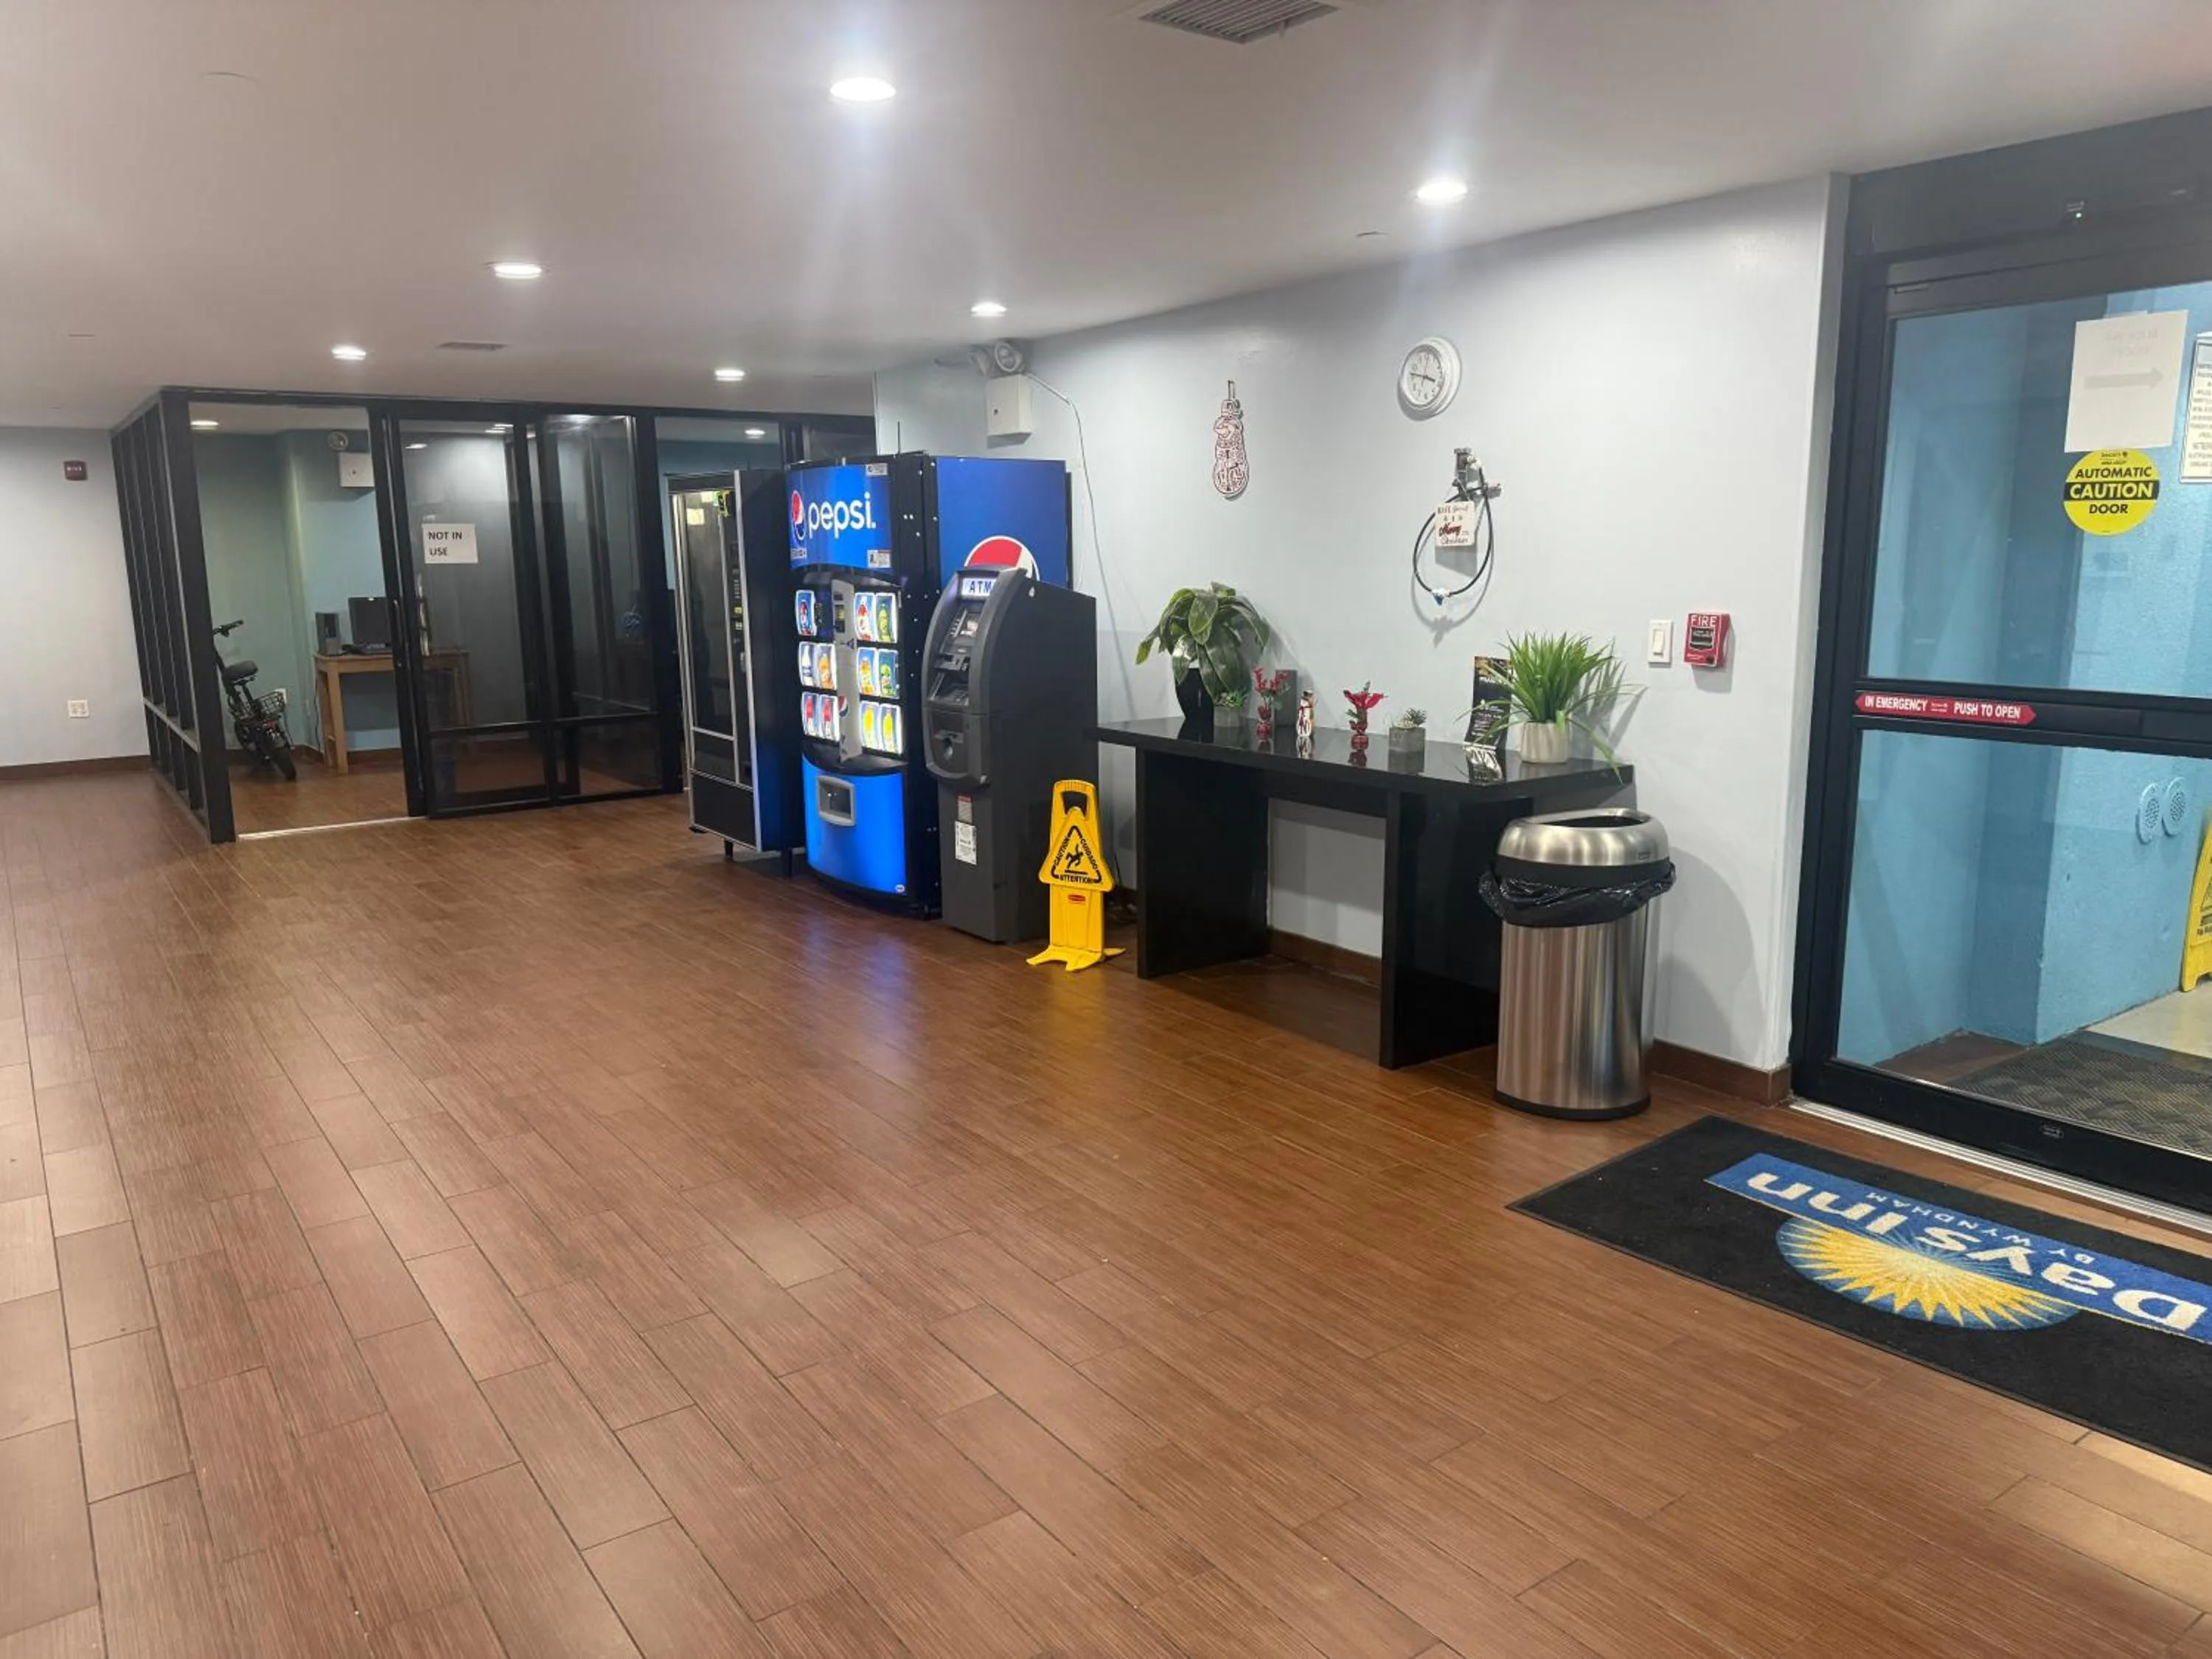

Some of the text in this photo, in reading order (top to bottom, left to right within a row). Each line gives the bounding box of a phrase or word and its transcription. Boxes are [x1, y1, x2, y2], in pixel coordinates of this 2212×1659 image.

[2076, 467, 2152, 479] AUTOMATIC
[2070, 482, 2153, 498] CAUTION
[2089, 504, 2129, 513] DOOR
[428, 532, 462, 540] NOT IN
[429, 547, 448, 556] USE
[970, 580, 992, 594] ATM
[1691, 614, 1717, 627] FIRE
[1865, 695, 1874, 707] IN
[1875, 696, 1928, 712] EMERGENCY
[1954, 702, 1978, 715] PUSH
[1981, 703, 1992, 717] TO
[1994, 704, 2021, 719] OPEN
[1866, 1192, 2096, 1265] BY WYNDHAM
